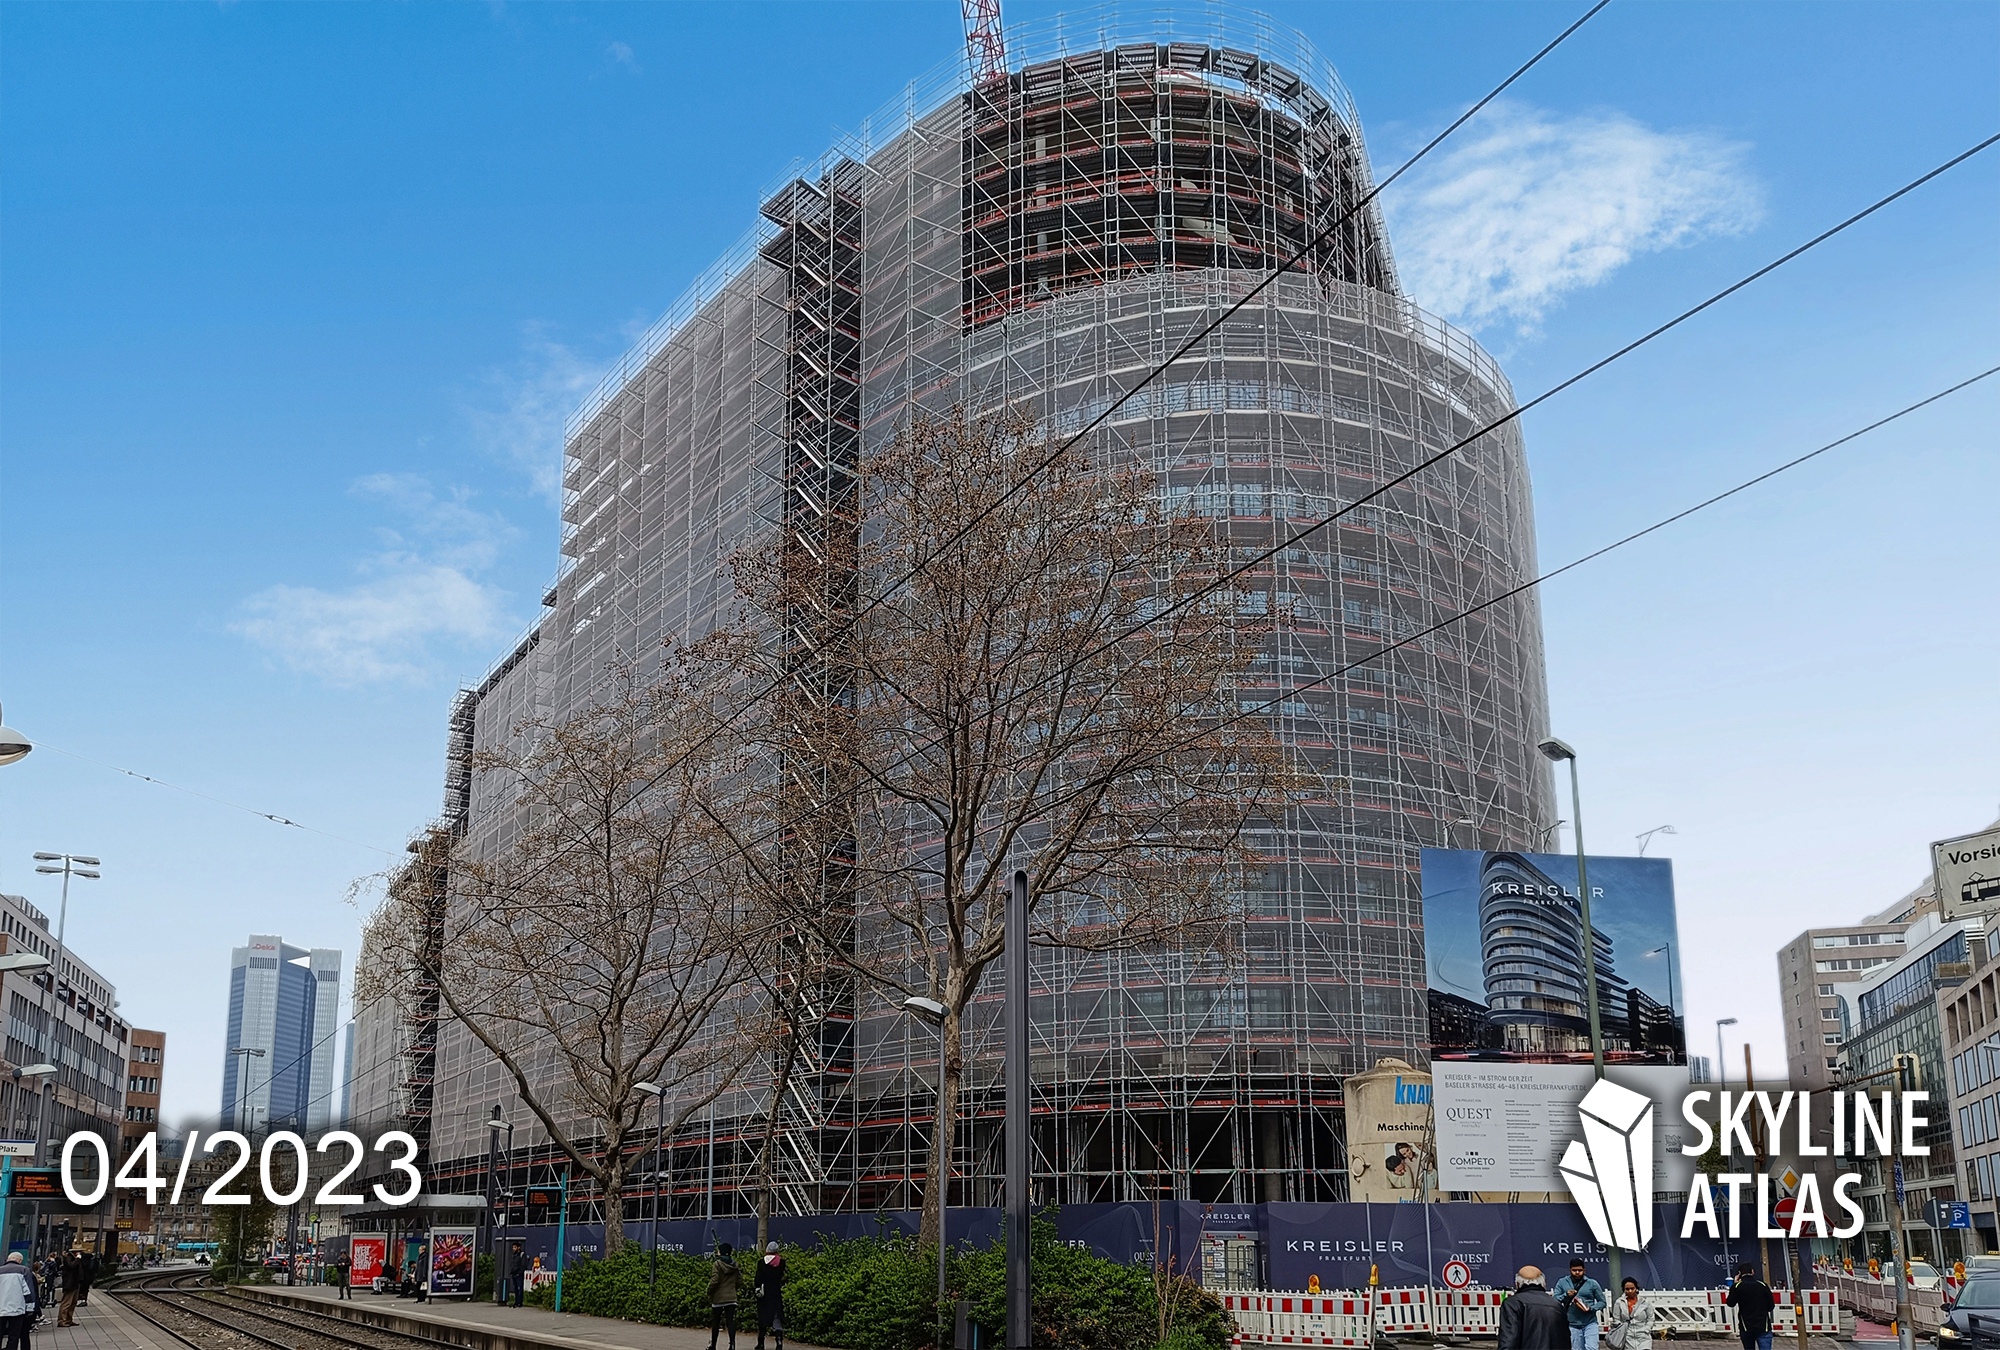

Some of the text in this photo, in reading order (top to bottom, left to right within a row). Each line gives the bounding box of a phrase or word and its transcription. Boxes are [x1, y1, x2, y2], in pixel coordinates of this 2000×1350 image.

[1948, 844, 2000, 865] Vorsi
[1446, 1107, 1492, 1121] QUEST
[1377, 1122, 1430, 1132] Maschine
[1450, 1157, 1495, 1166] COMPETO
[1287, 1240, 1404, 1252] KREISLER
[1543, 1242, 1649, 1254] KREISER
[1714, 1254, 1739, 1265] QUST
